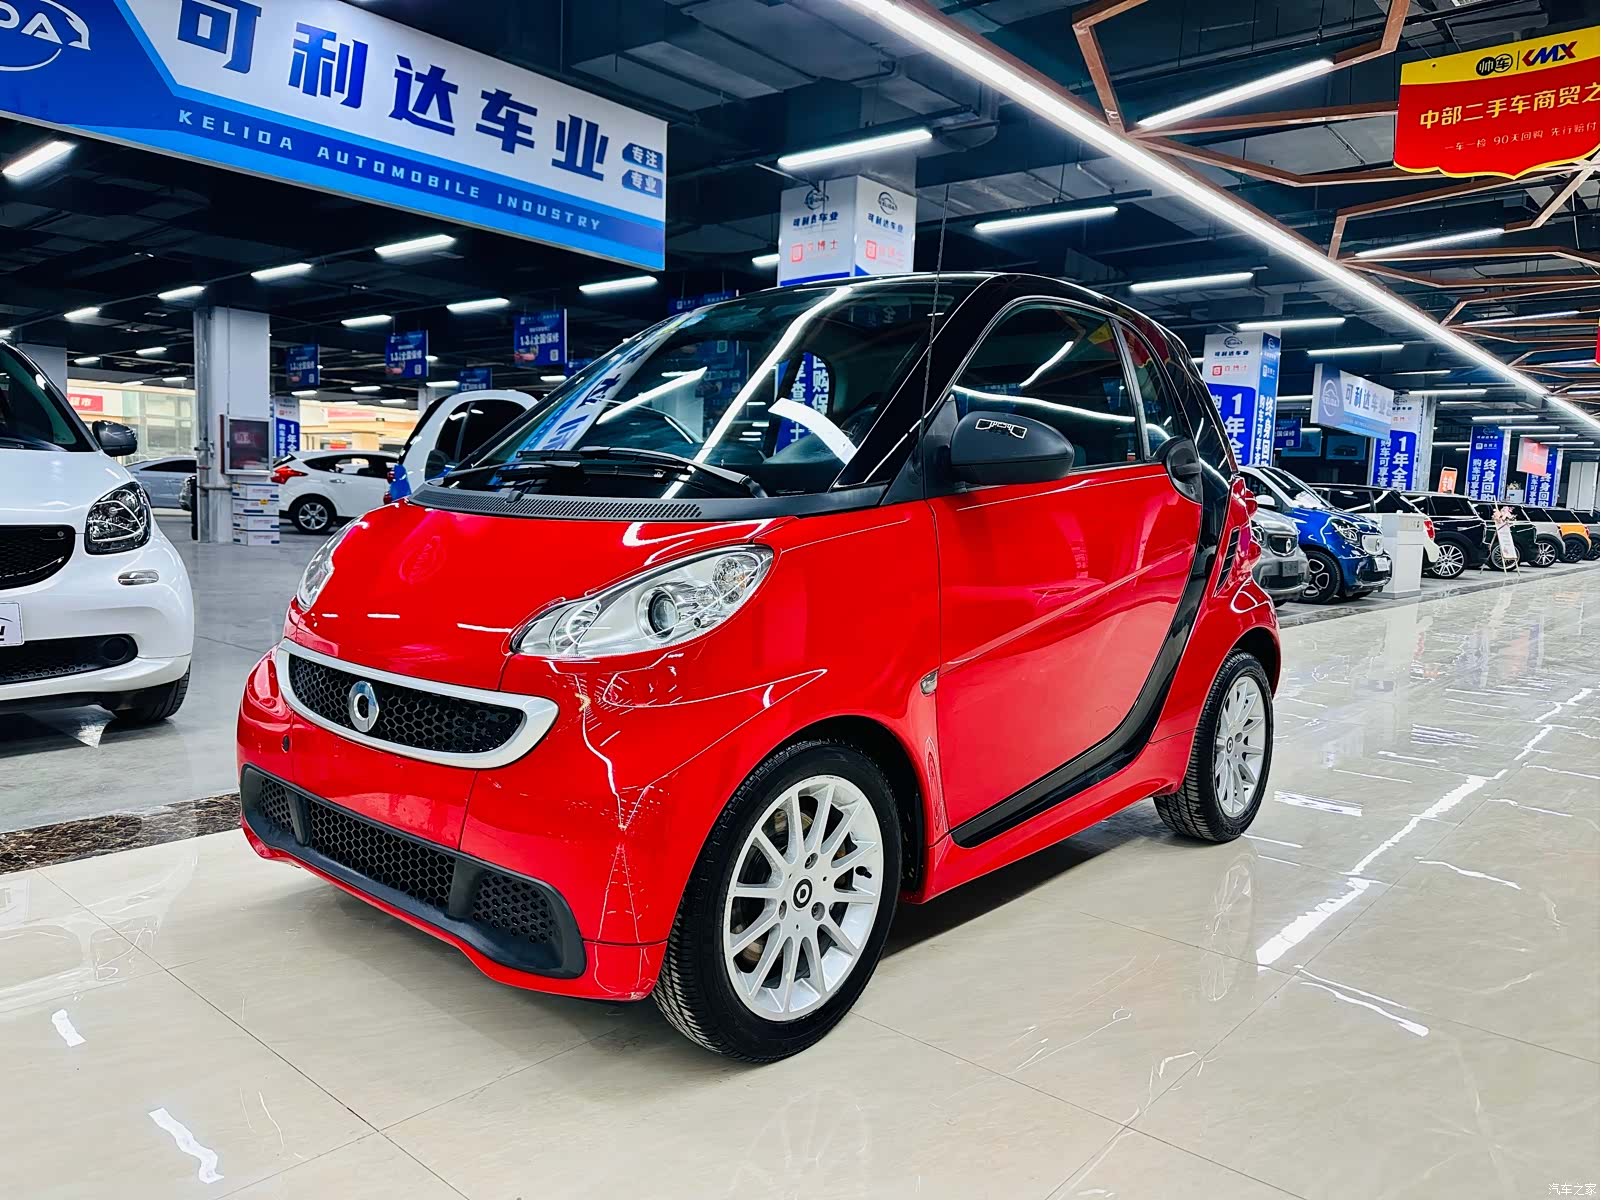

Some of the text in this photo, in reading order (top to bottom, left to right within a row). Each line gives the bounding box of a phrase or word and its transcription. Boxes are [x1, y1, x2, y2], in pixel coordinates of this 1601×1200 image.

[177, 0, 609, 181] 可利达车业
[1420, 82, 1600, 129] 中部二手车商贸之
[178, 109, 601, 231] KELIDA AUTOMOBILE INDUSTRY
[631, 146, 658, 169] 专注
[631, 171, 657, 194] 专业
